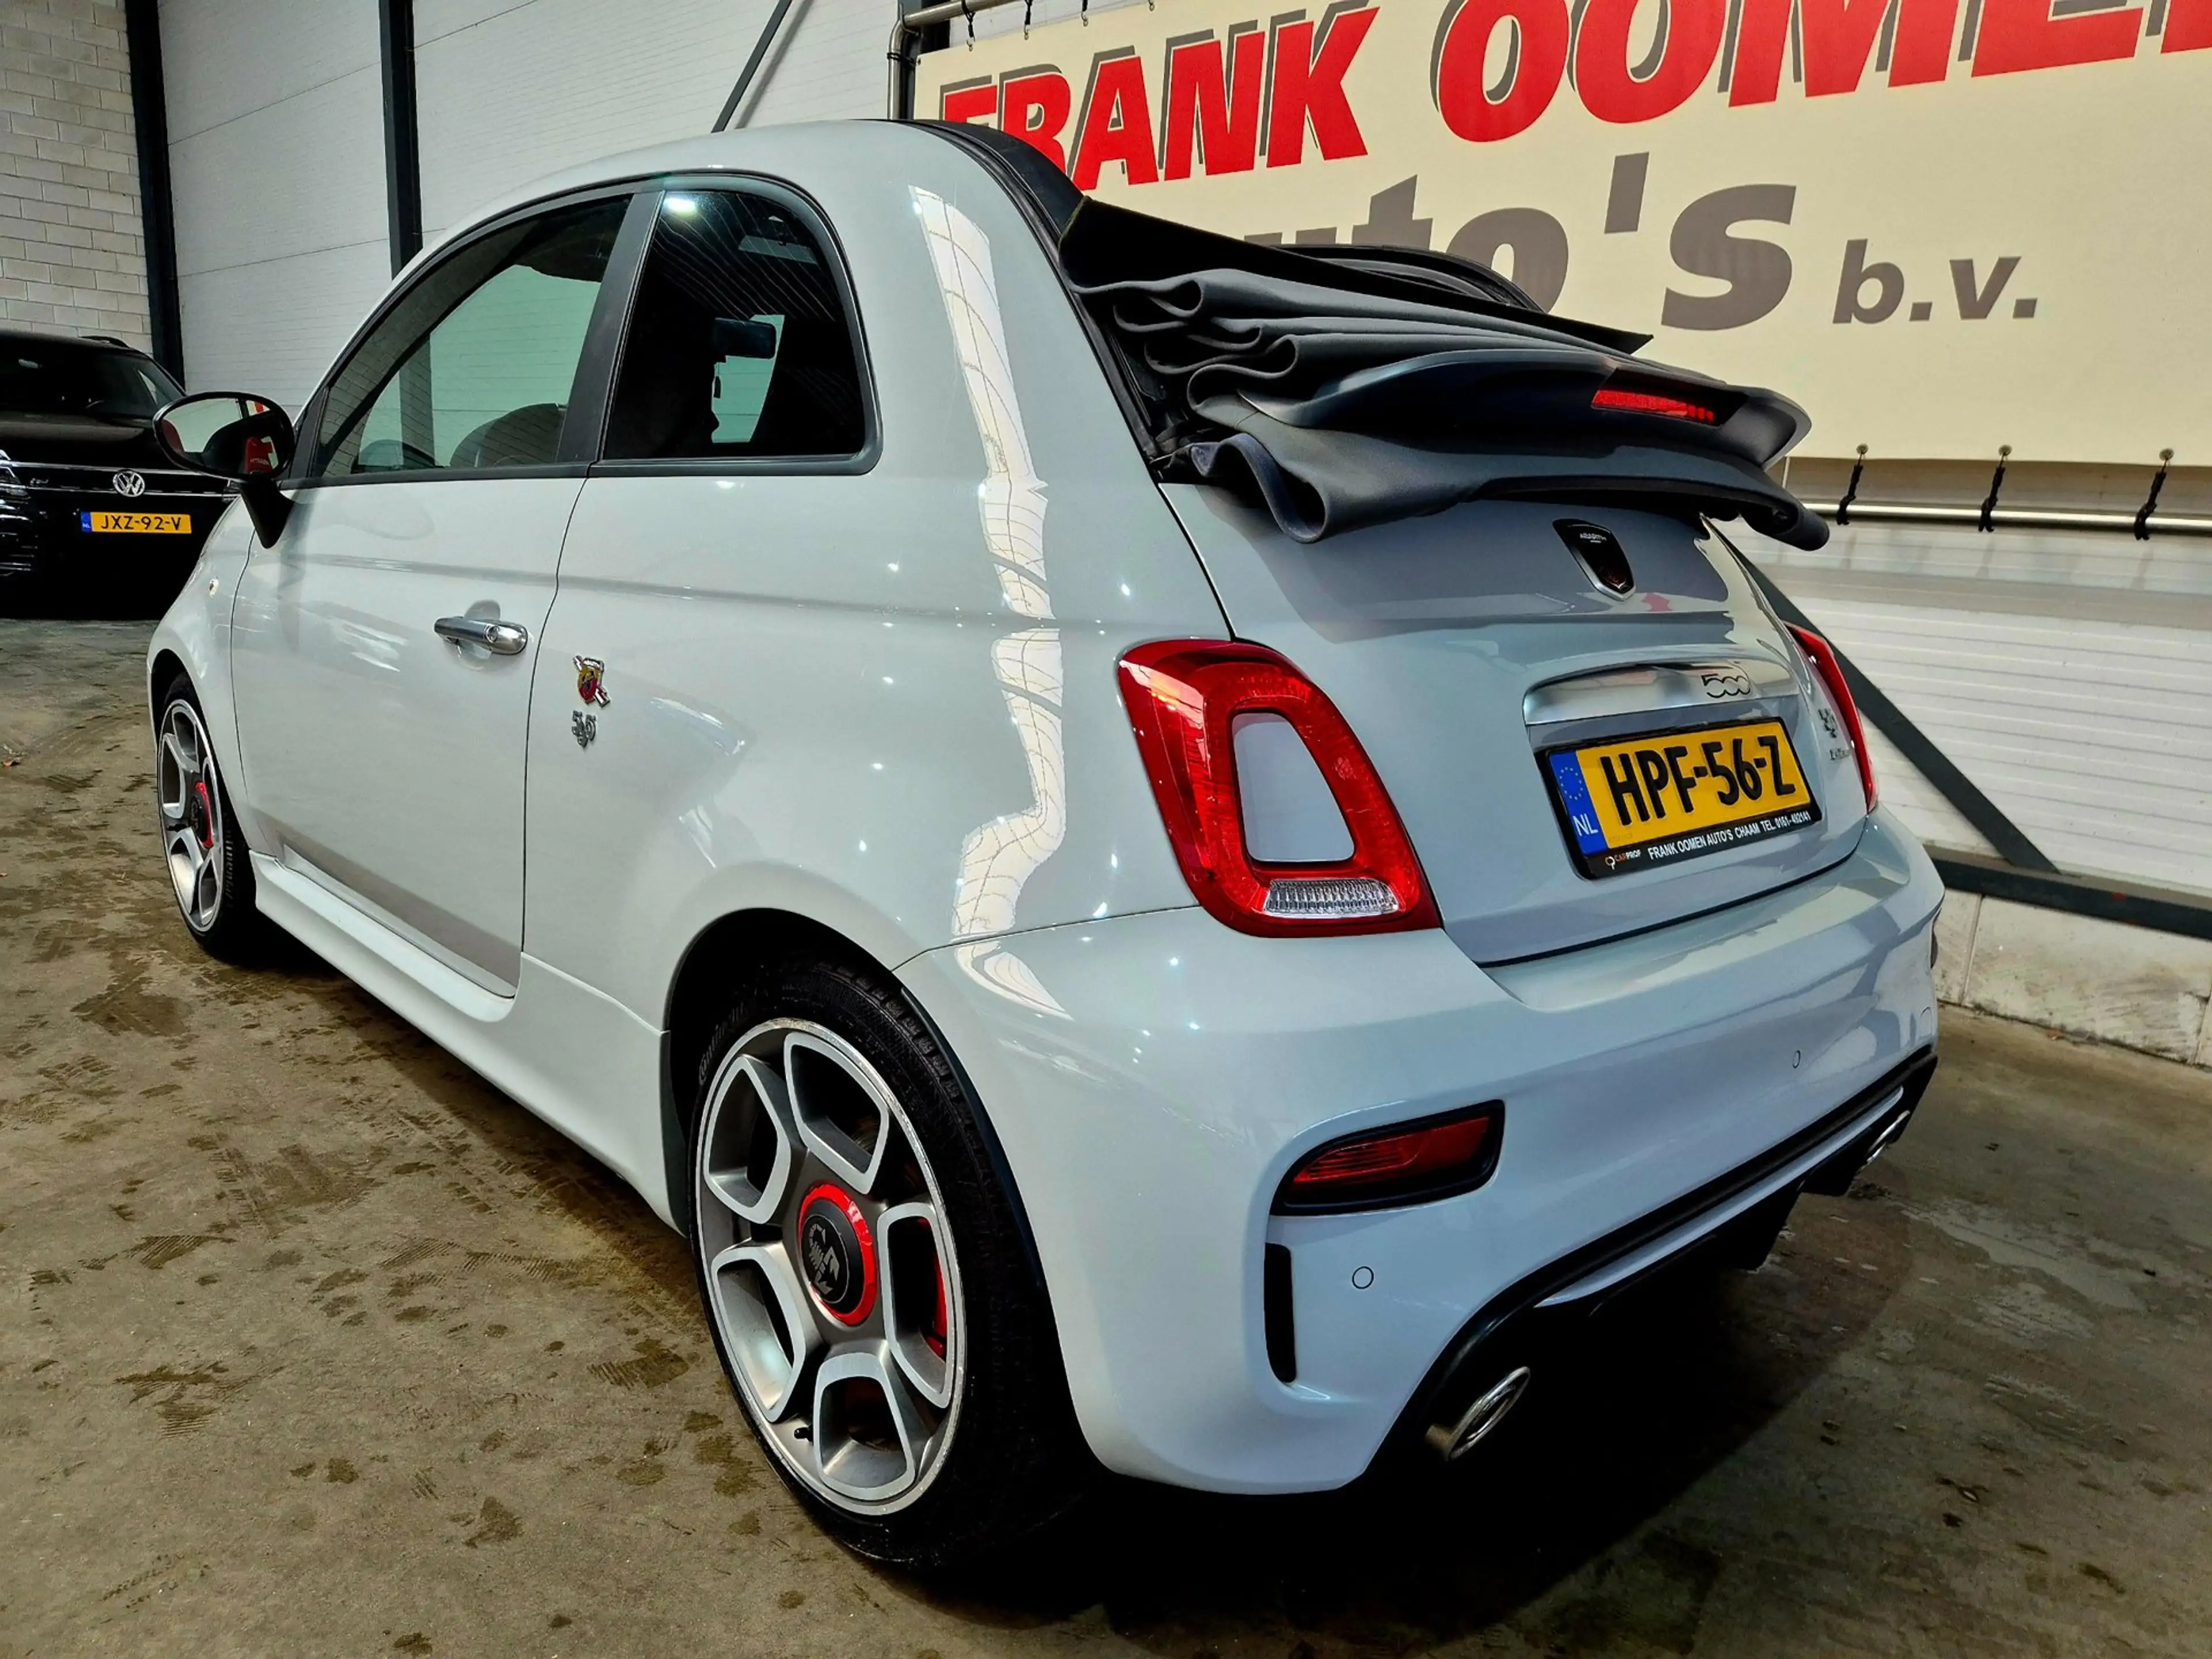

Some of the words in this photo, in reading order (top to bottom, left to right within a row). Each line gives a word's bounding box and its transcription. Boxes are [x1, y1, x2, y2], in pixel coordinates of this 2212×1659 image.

[1431, 0, 2212, 142] OOM
[1832, 238, 2037, 325] b.v.
[101, 515, 181, 531] JXZ-92-V
[1700, 673, 1751, 698] 500
[1573, 813, 1599, 836] NL
[1600, 736, 1796, 826] HPF-56-Z
[1647, 843, 1679, 860] FRANK
[1677, 835, 1708, 853] OOMEN
[1707, 828, 1733, 846] AUTO'S
[1734, 823, 1760, 839] CHAAM
